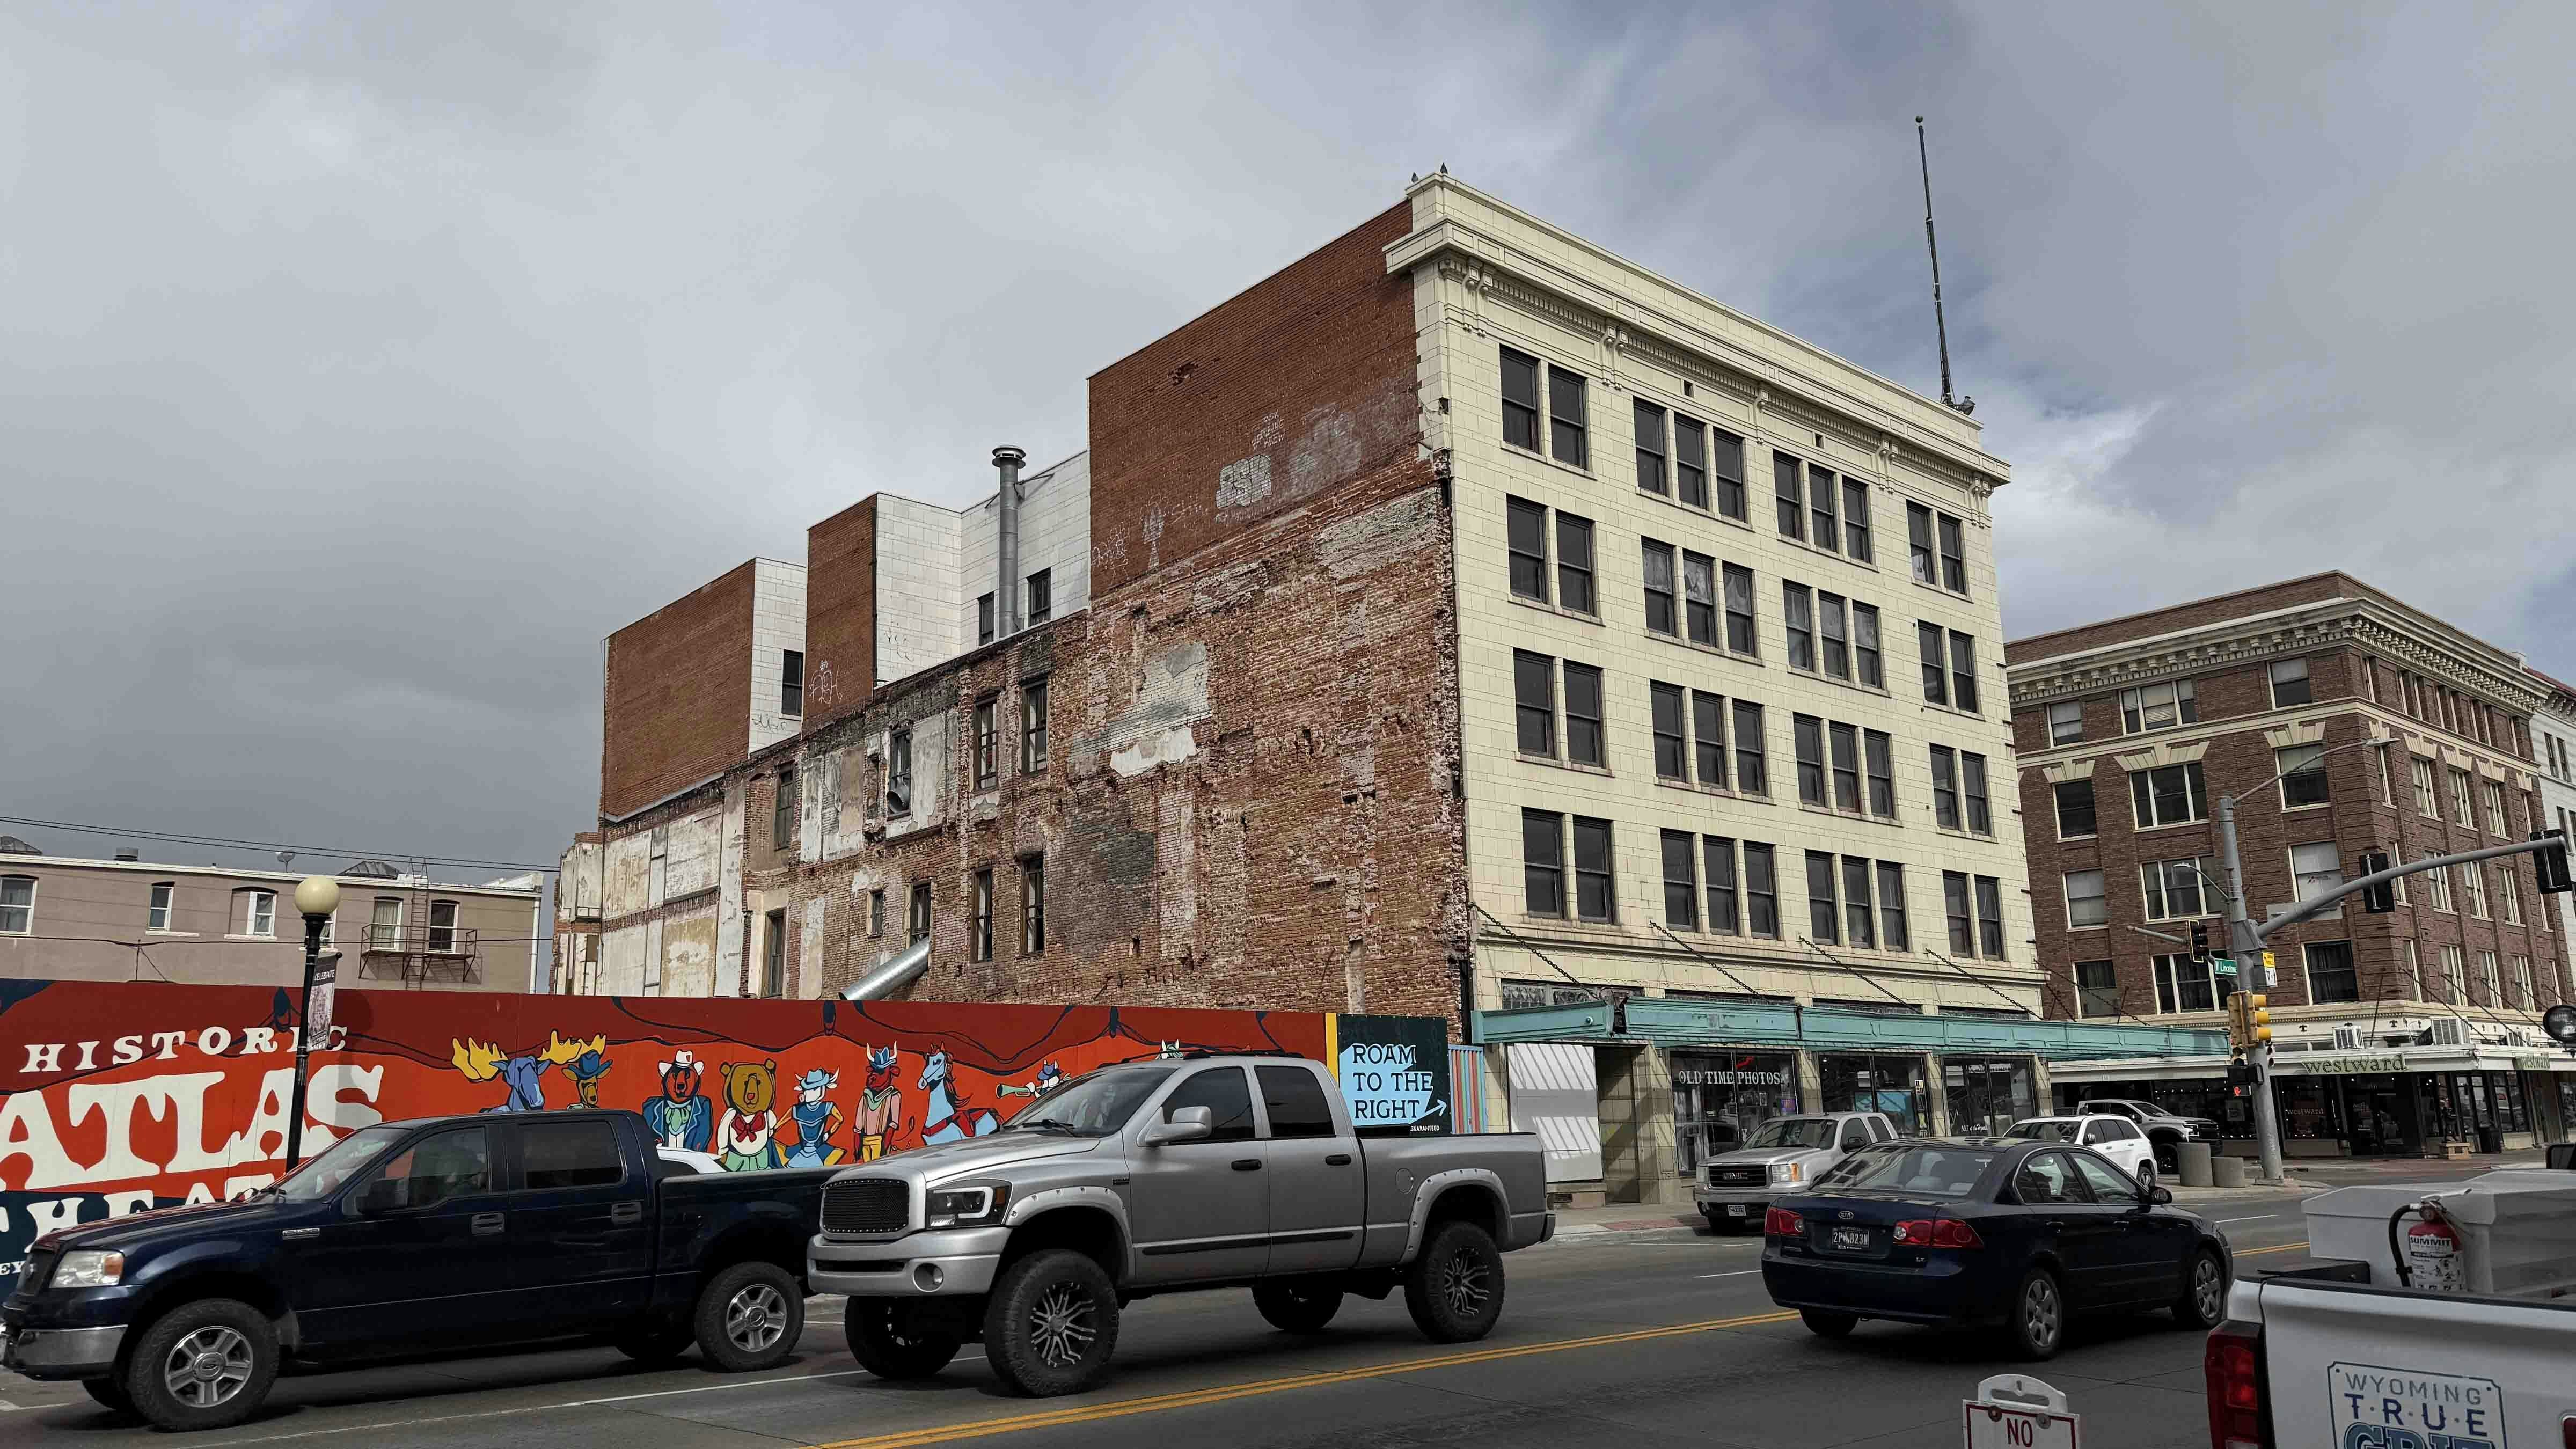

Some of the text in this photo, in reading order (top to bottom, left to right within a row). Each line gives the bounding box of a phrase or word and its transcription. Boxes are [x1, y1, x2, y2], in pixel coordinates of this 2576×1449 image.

[1352, 1044, 1416, 1064] ROAM
[2302, 1052, 2409, 1073] westward
[1353, 1072, 1432, 1091] TO THE
[1679, 1071, 1782, 1085] OLD TIME PHOTOS
[1354, 1100, 1419, 1118] RIGHT
[0, 1064, 383, 1190] ATLAS
[2410, 1236, 2451, 1246] SUMMIT
[2345, 1372, 2482, 1405] WYOMING
[2007, 1417, 2033, 1448] NO
